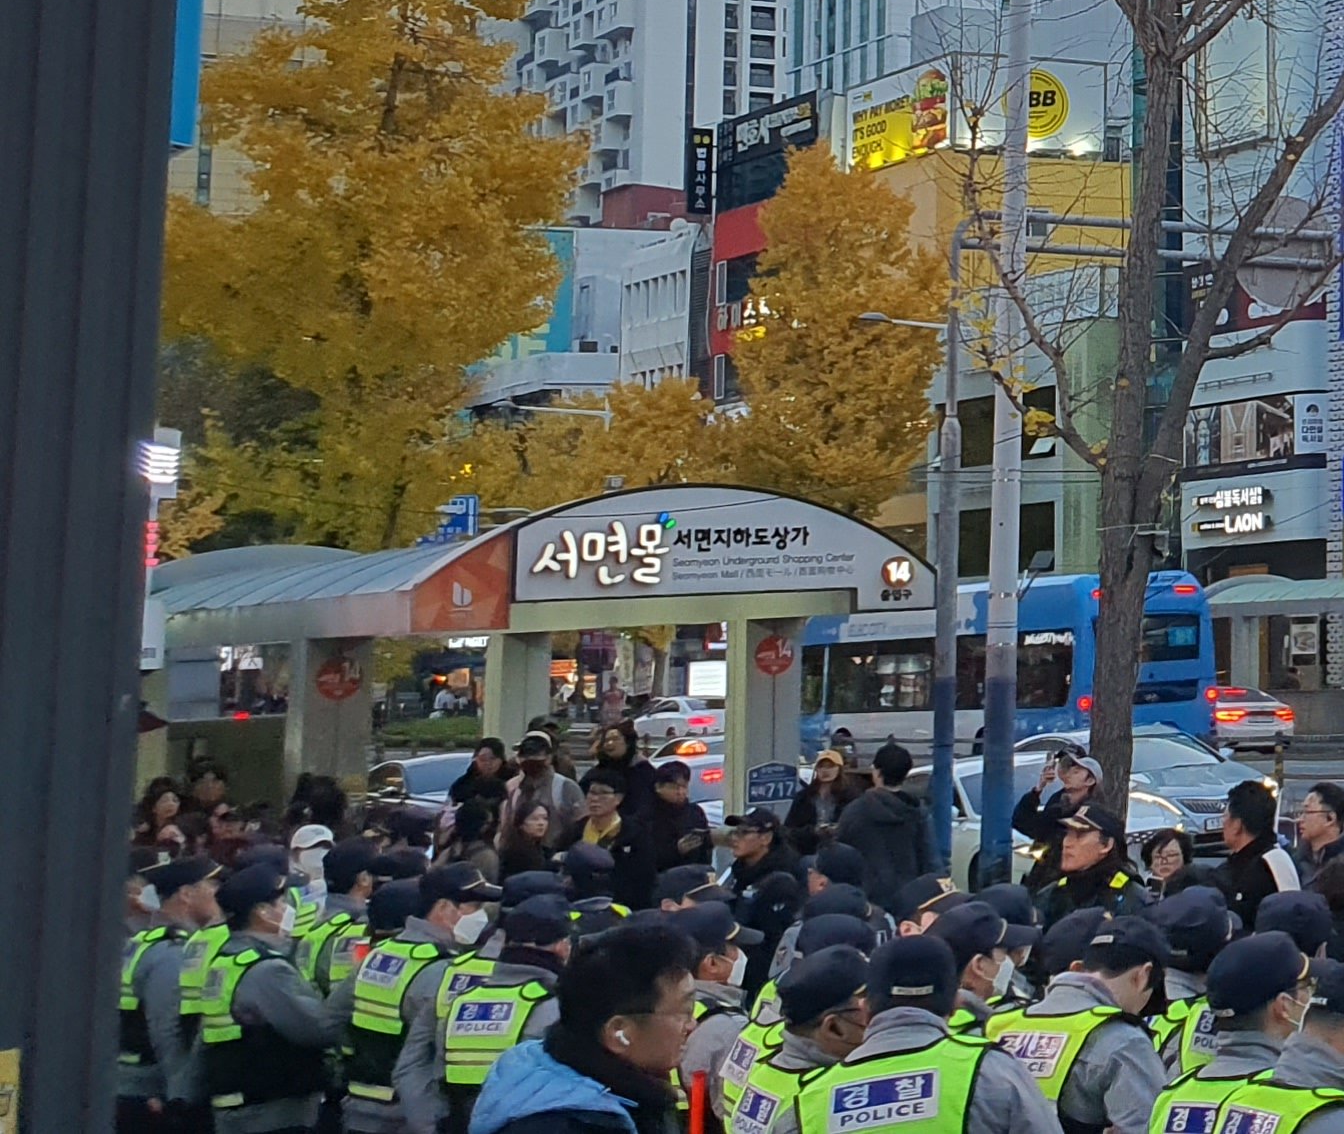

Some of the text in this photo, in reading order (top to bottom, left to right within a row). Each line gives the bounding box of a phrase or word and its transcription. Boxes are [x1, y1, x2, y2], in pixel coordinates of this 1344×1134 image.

[1029, 90, 1056, 108] BB
[867, 119, 887, 139] GOOD
[1224, 512, 1263, 533] LAON
[530, 519, 810, 585] 서면몰 서면지하도상가
[722, 554, 780, 567] Underground
[782, 553, 824, 566] Shopping
[825, 552, 856, 563] Center
[721, 569, 739, 579] Mall
[885, 561, 910, 582] 14
[766, 781, 794, 799] 717
[455, 1021, 503, 1034] POLICE
[841, 1075, 926, 1110] 경찰
[840, 1102, 926, 1127] POLICE
